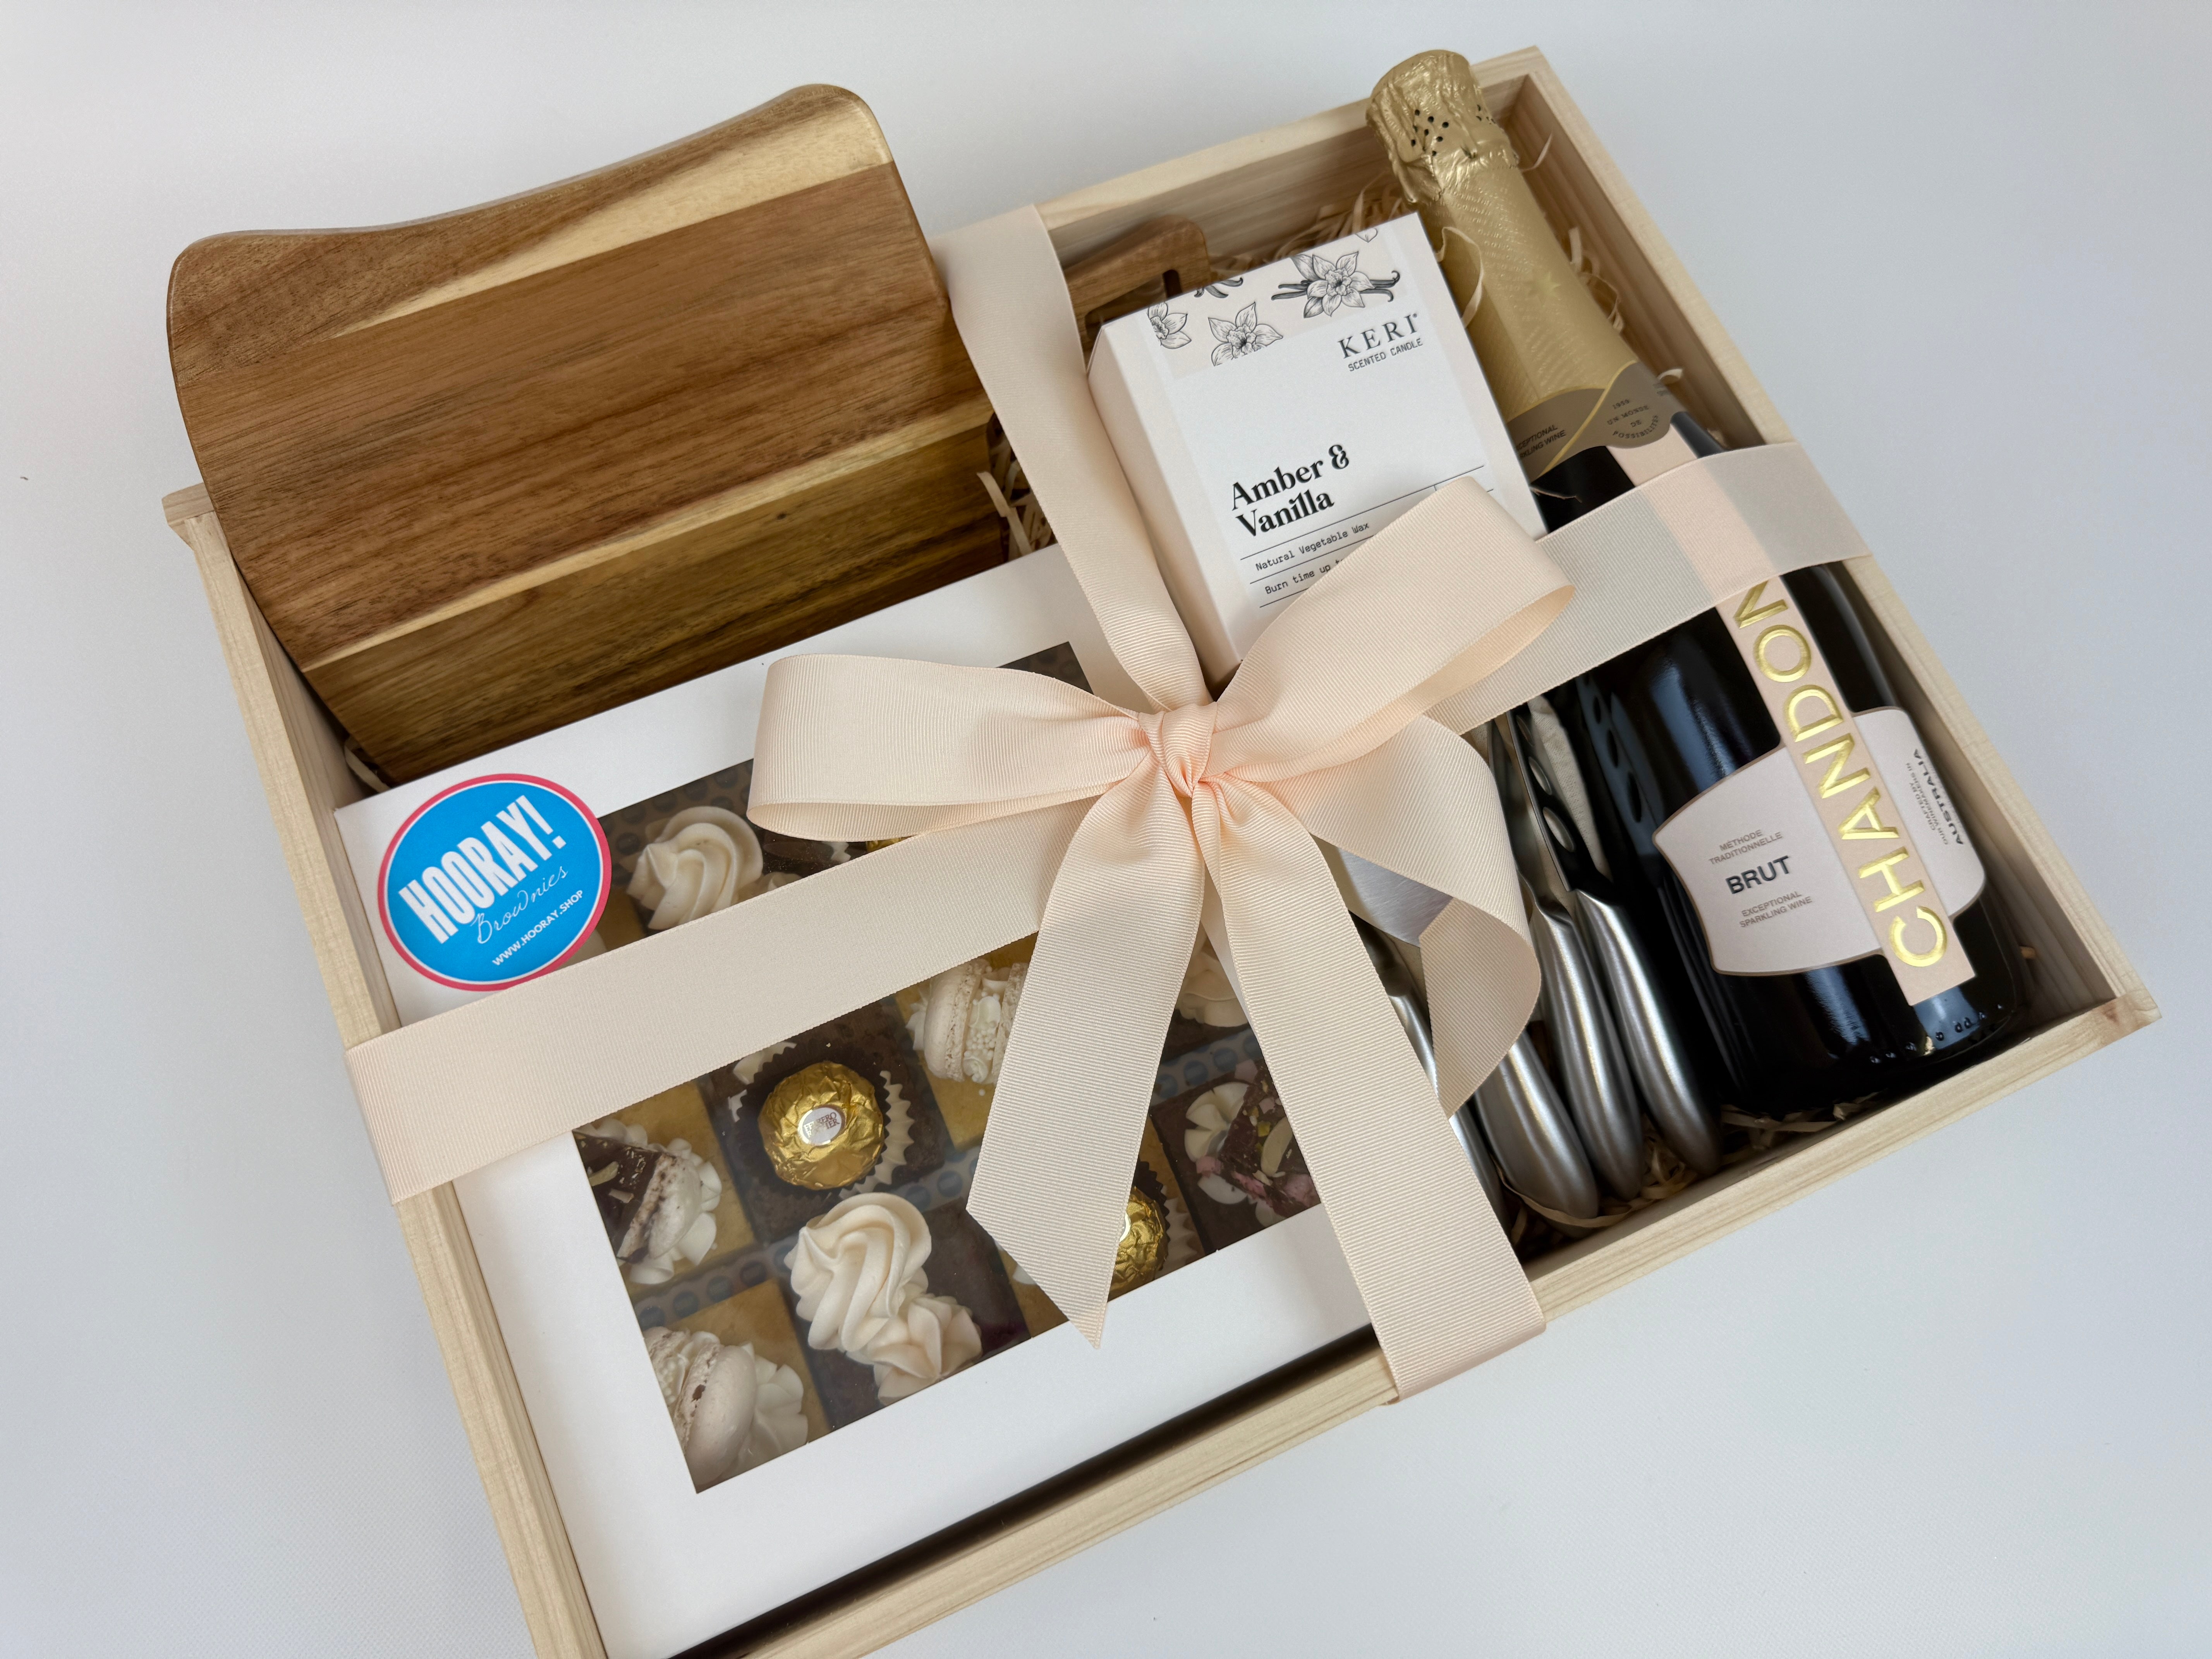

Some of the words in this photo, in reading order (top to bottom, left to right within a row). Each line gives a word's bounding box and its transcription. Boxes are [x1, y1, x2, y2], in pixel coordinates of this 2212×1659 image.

[1337, 314, 1417, 359] KERI
[1348, 352, 1386, 371] SCENTED
[1390, 338, 1423, 356] CANDLE
[1607, 416, 1619, 425] UN
[1621, 406, 1649, 418] MONDE
[1516, 424, 1558, 451] CEPTIONAL
[1520, 442, 1544, 459] RKLING
[1544, 430, 1566, 445] WINE
[1232, 460, 1324, 511] Amber
[1328, 444, 1350, 470] &
[1235, 489, 1335, 537] Vanilla
[1255, 550, 1295, 571] Natural
[1299, 532, 1348, 555] Vegetable
[1351, 523, 1370, 534] Wax
[1265, 580, 1288, 594] Burn
[1293, 570, 1315, 584] time
[1319, 565, 1331, 573] up
[1905, 763, 1912, 771] IN
[1909, 783, 1917, 792] BY
[1911, 772, 1939, 826] WINEMAKERS
[1914, 749, 1964, 845] AUSTRALIA
[1916, 794, 1936, 830] CRAFTED
[1709, 832, 1783, 864] TRADITIONNELLE
[1938, 828, 1948, 845] OUR
[398, 795, 567, 944] HOORAY!
[1725, 855, 1791, 894] BRUT
[471, 865, 568, 944] Brownies
[1739, 906, 1787, 927] SPARKLING
[1788, 896, 1812, 912] WINE
[1742, 891, 1802, 917] EXCEPTIONAL
[492, 890, 584, 966] WWW.HOORAY.SHOP
